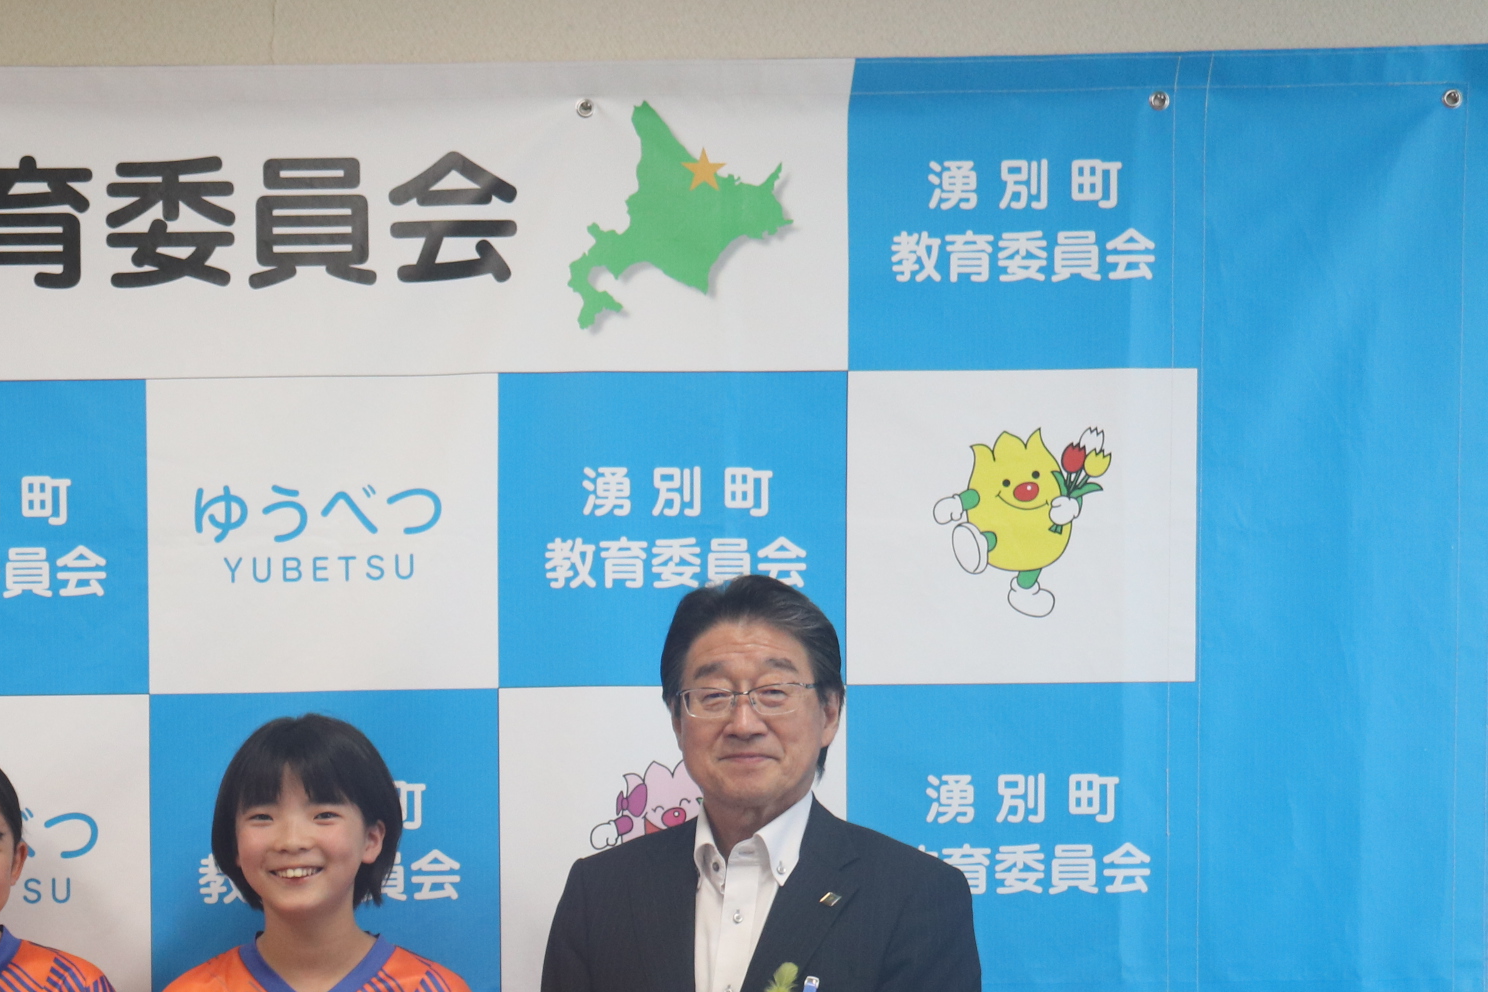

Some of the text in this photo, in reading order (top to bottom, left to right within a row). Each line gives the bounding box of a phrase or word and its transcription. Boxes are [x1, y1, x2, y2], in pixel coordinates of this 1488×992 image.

[927, 158, 1123, 211] 湧別町
[890, 227, 1156, 283] 教育委員会
[194, 485, 442, 544] ゆうべつ
[581, 466, 774, 518] 湧別町
[223, 554, 414, 584] YUBETSU
[544, 536, 807, 590] 教育委員会
[925, 772, 1120, 824] 湧別町
[917, 842, 1151, 895] 育委員会
